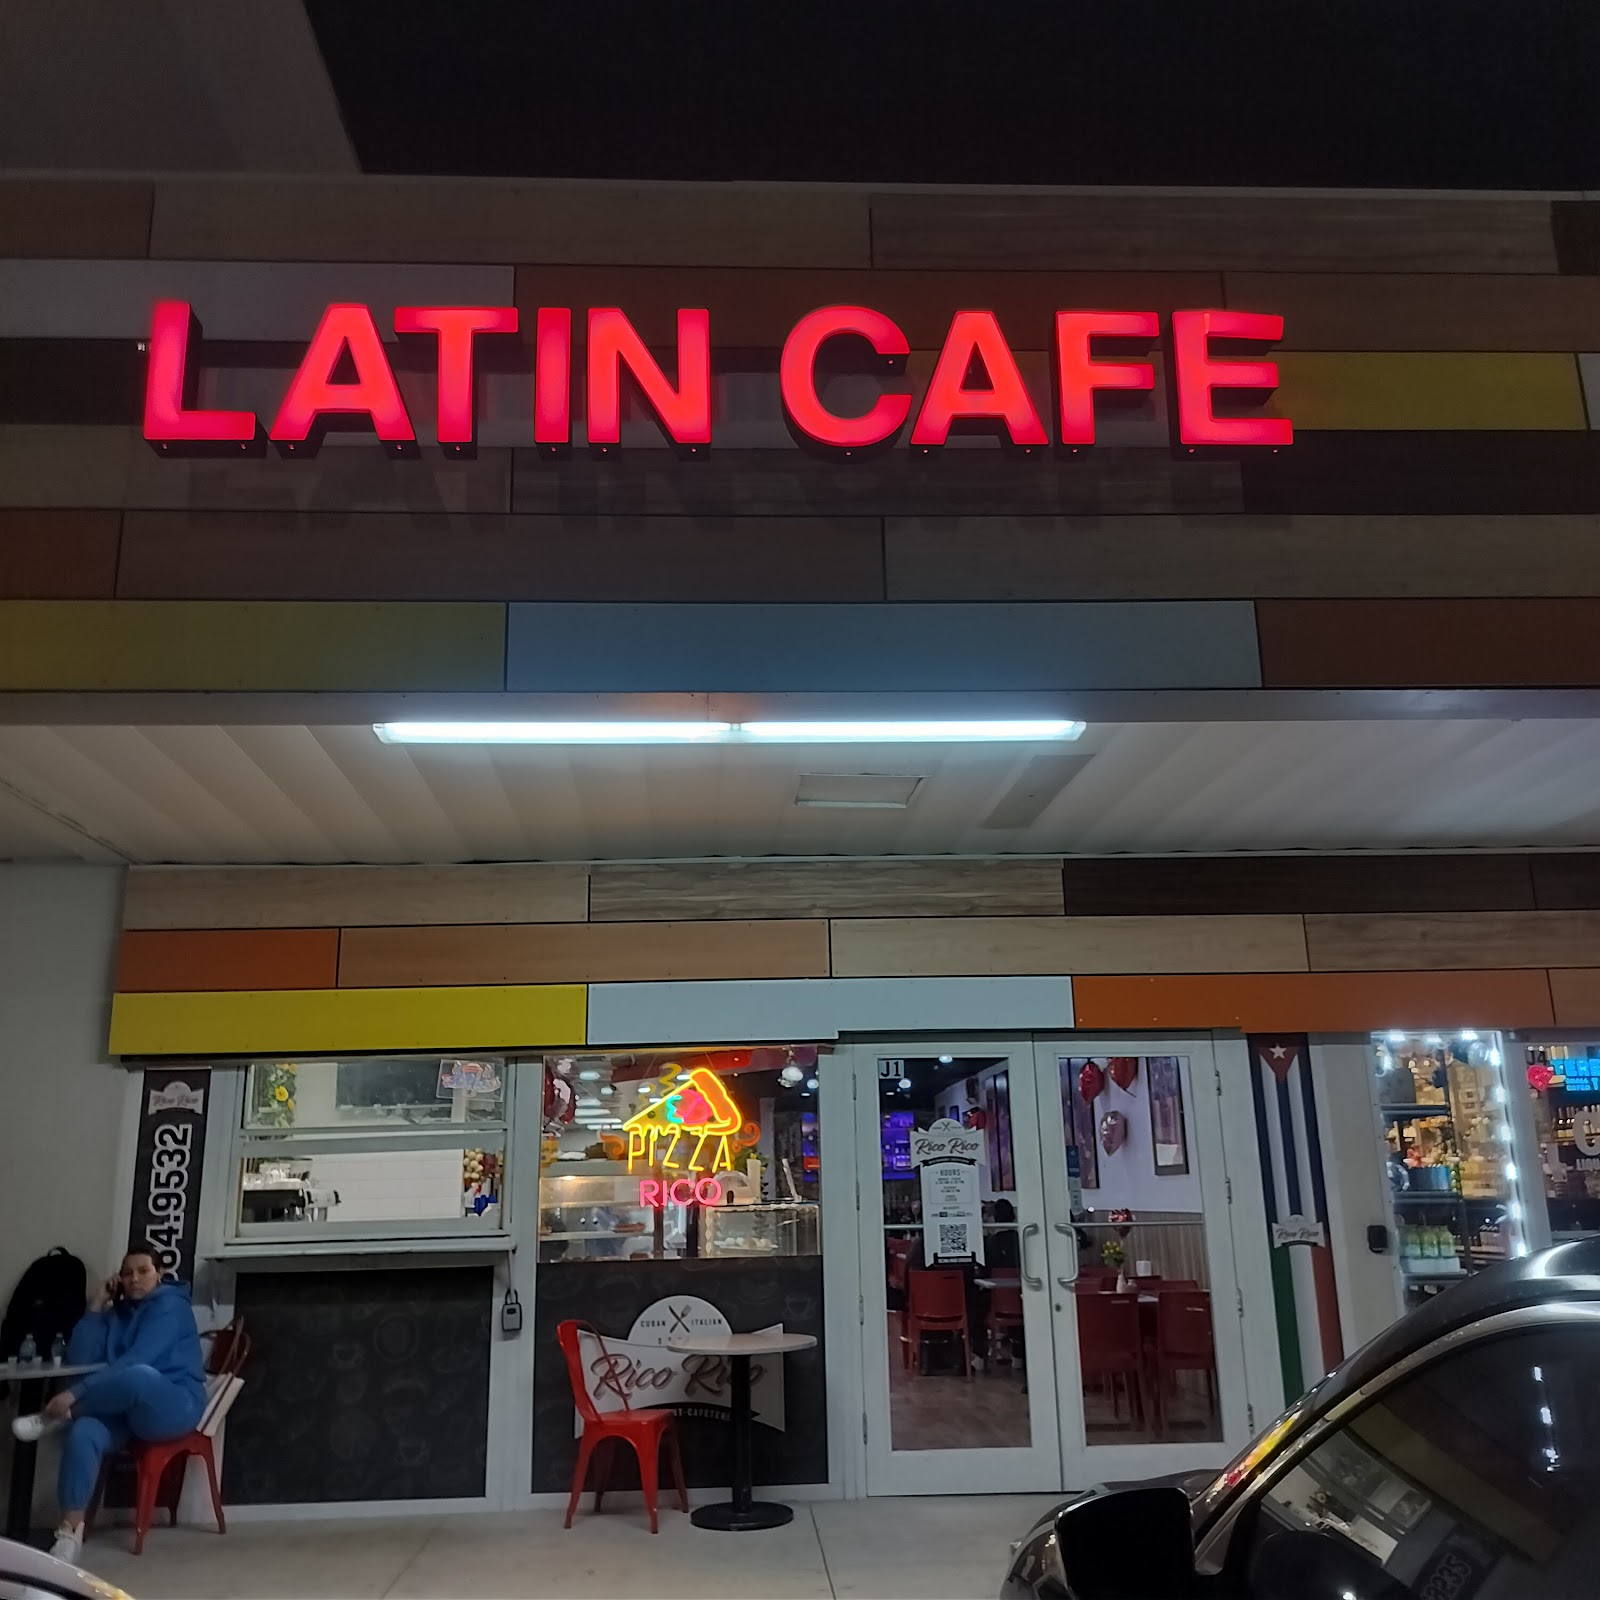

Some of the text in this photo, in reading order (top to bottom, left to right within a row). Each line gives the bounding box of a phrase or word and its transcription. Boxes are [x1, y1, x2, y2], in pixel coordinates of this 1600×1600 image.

[143, 299, 1295, 449] LATIN CAFE
[880, 1060, 901, 1078] J1
[627, 1130, 733, 1174] PIZZA
[915, 1137, 980, 1155] Rico Rico
[639, 1177, 722, 1208] RICO
[691, 1318, 723, 1326] ITALIAN
[590, 1353, 768, 1400] Rico Rio
